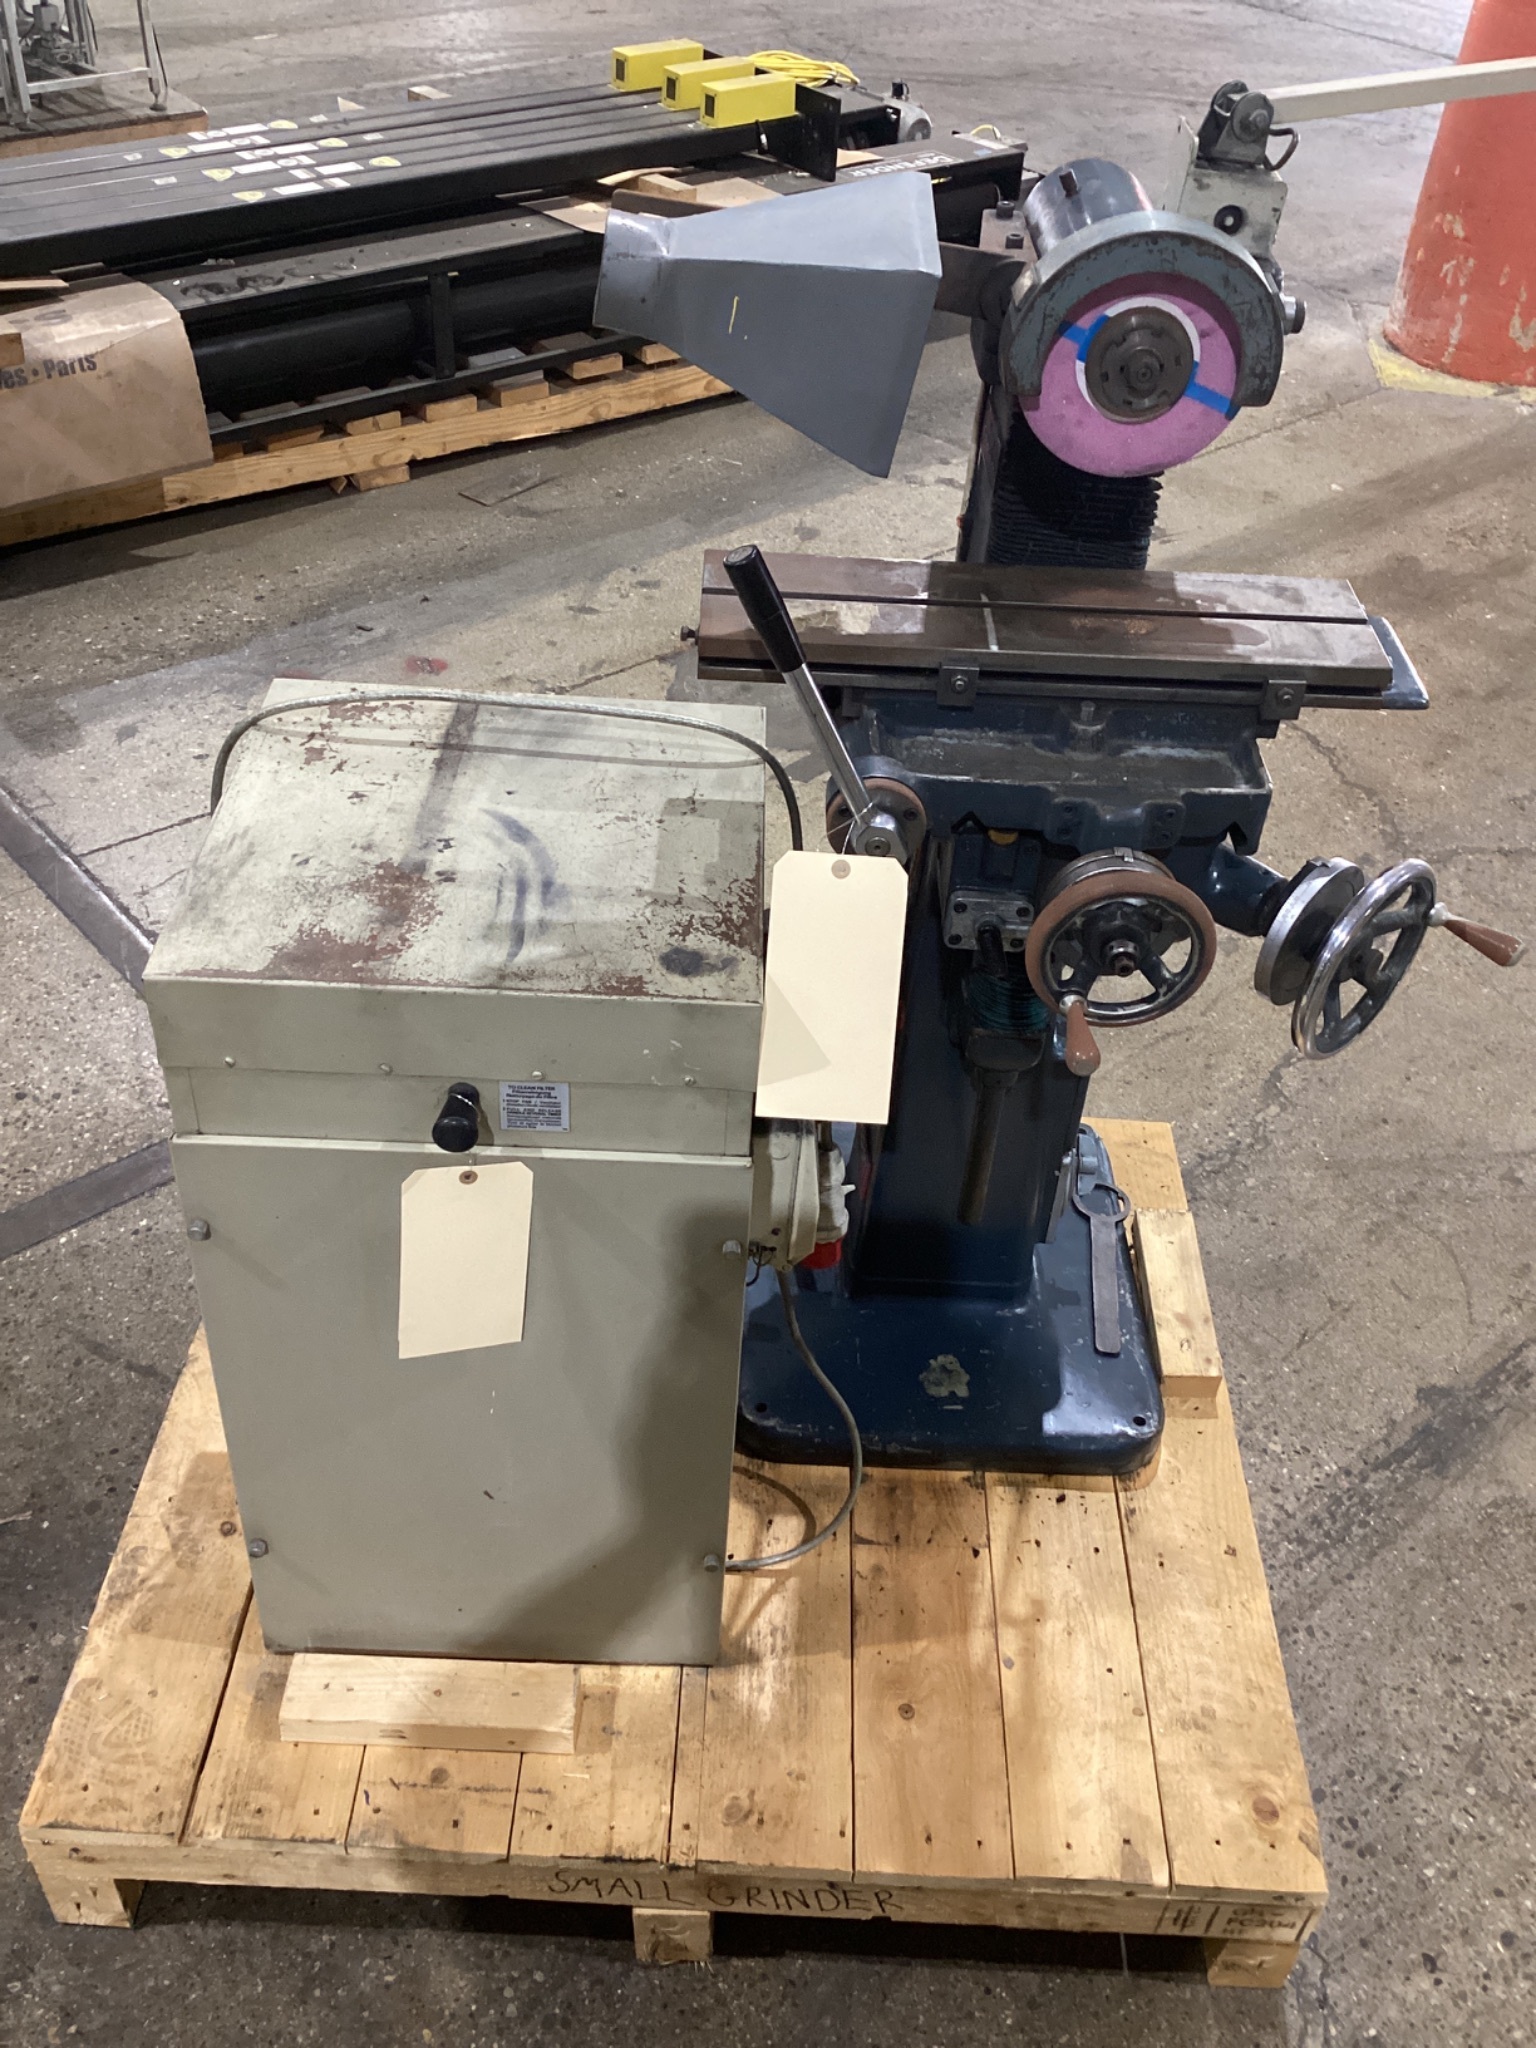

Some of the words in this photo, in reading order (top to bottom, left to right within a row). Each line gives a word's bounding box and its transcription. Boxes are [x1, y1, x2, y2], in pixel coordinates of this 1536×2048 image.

[850, 155, 953, 178] DEFENDER
[43, 354, 98, 380] Parts
[549, 1868, 696, 1906] SMALL
[707, 1882, 904, 1914] GRINDER
